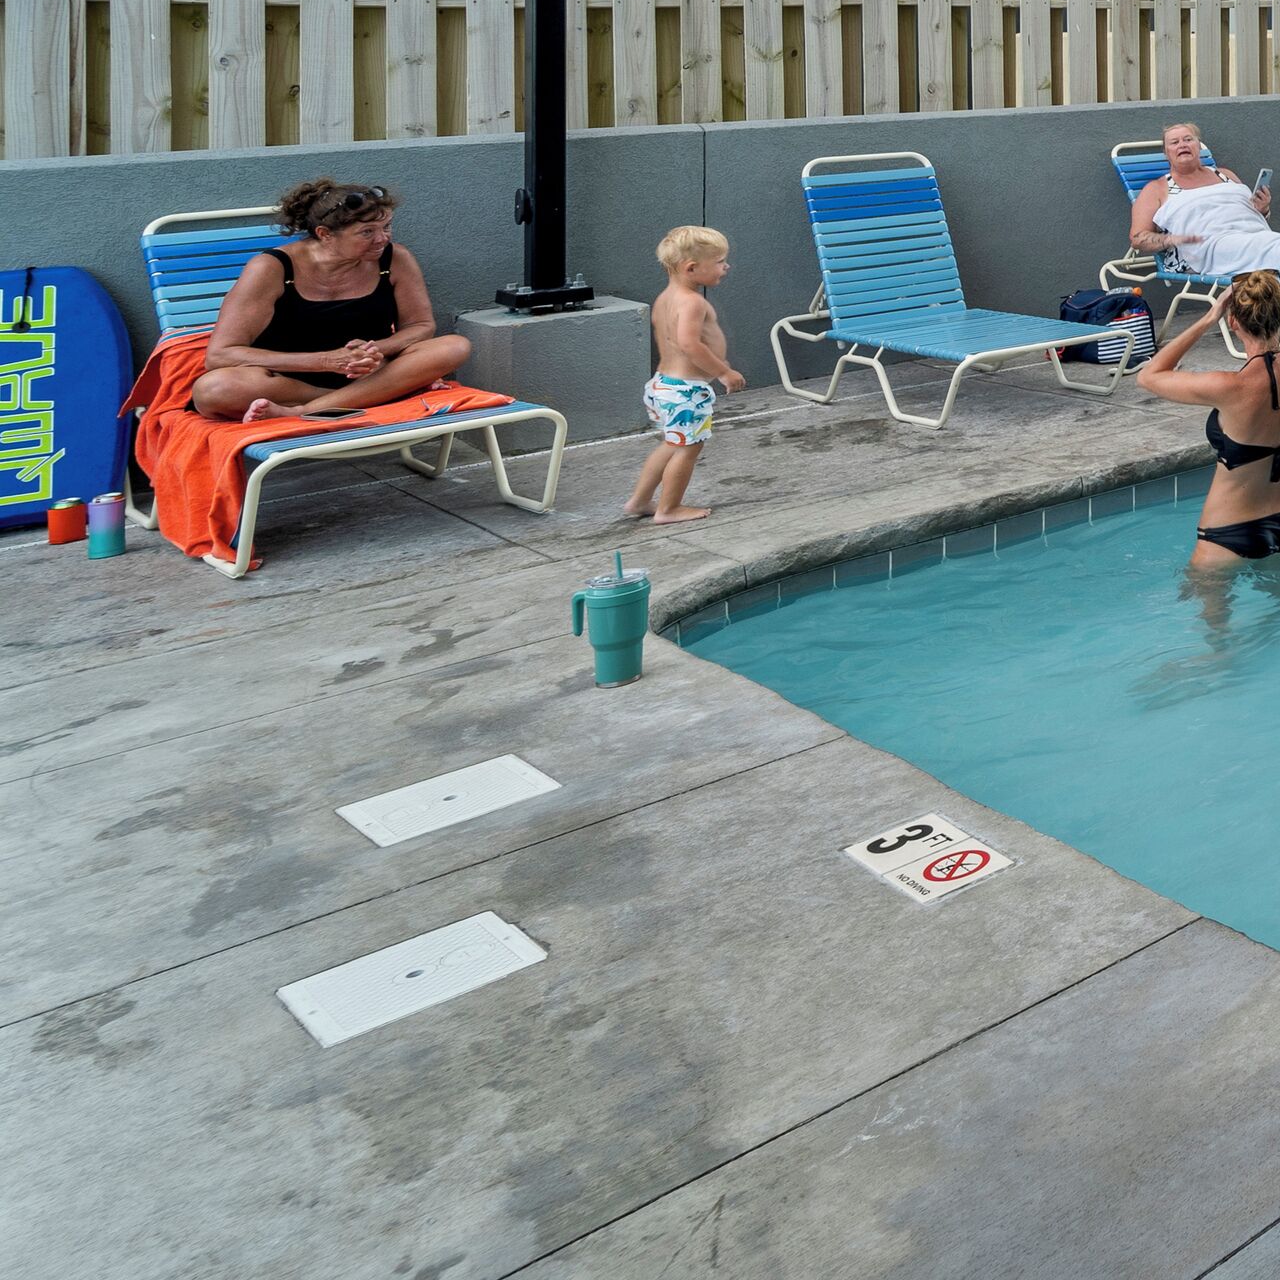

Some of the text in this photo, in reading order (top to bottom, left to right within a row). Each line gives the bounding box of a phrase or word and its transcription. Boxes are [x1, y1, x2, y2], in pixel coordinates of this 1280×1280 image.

[867, 824, 953, 854] 3 FT
[896, 873, 931, 896] NO DIVING
